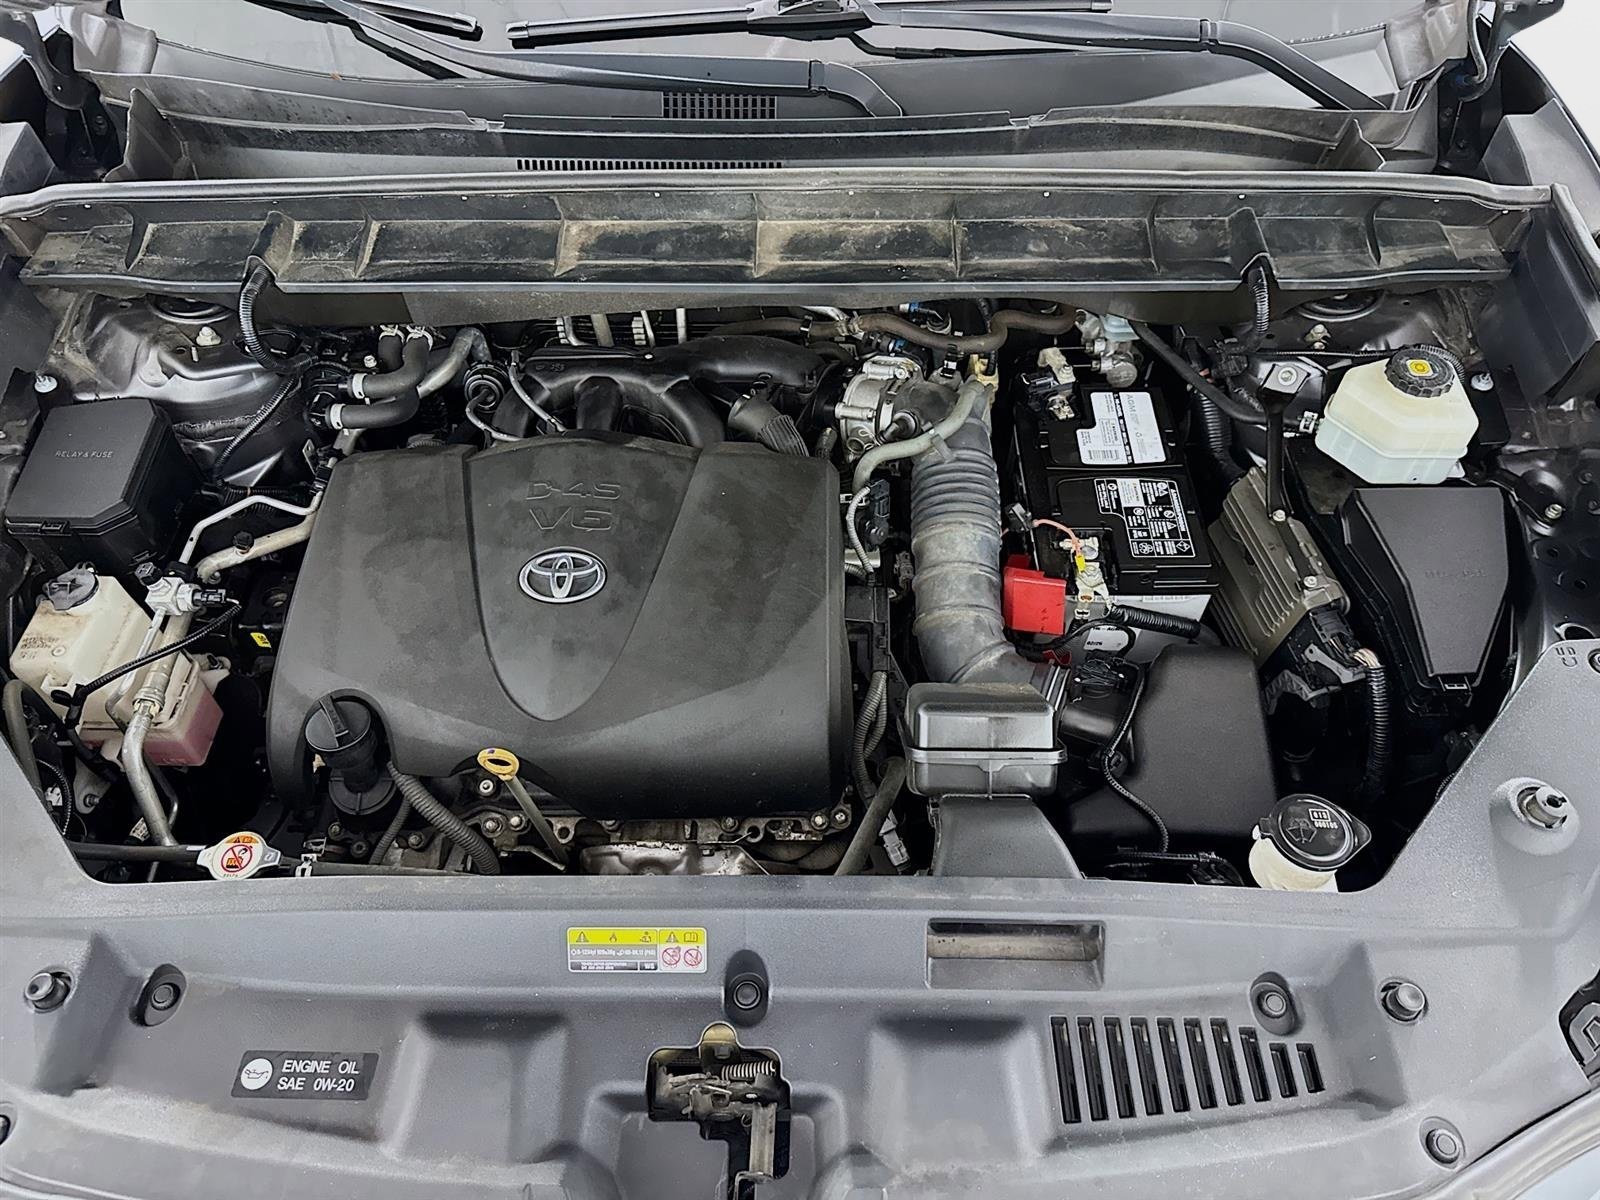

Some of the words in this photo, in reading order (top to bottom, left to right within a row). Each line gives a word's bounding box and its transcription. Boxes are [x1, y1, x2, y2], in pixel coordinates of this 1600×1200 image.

[90, 450, 113, 458] FUSE
[529, 506, 614, 532] V6
[281, 1059, 332, 1074] ENGINE
[338, 1060, 360, 1074] OIL
[277, 1076, 306, 1091] SAE
[313, 1078, 355, 1092] 0W-20
